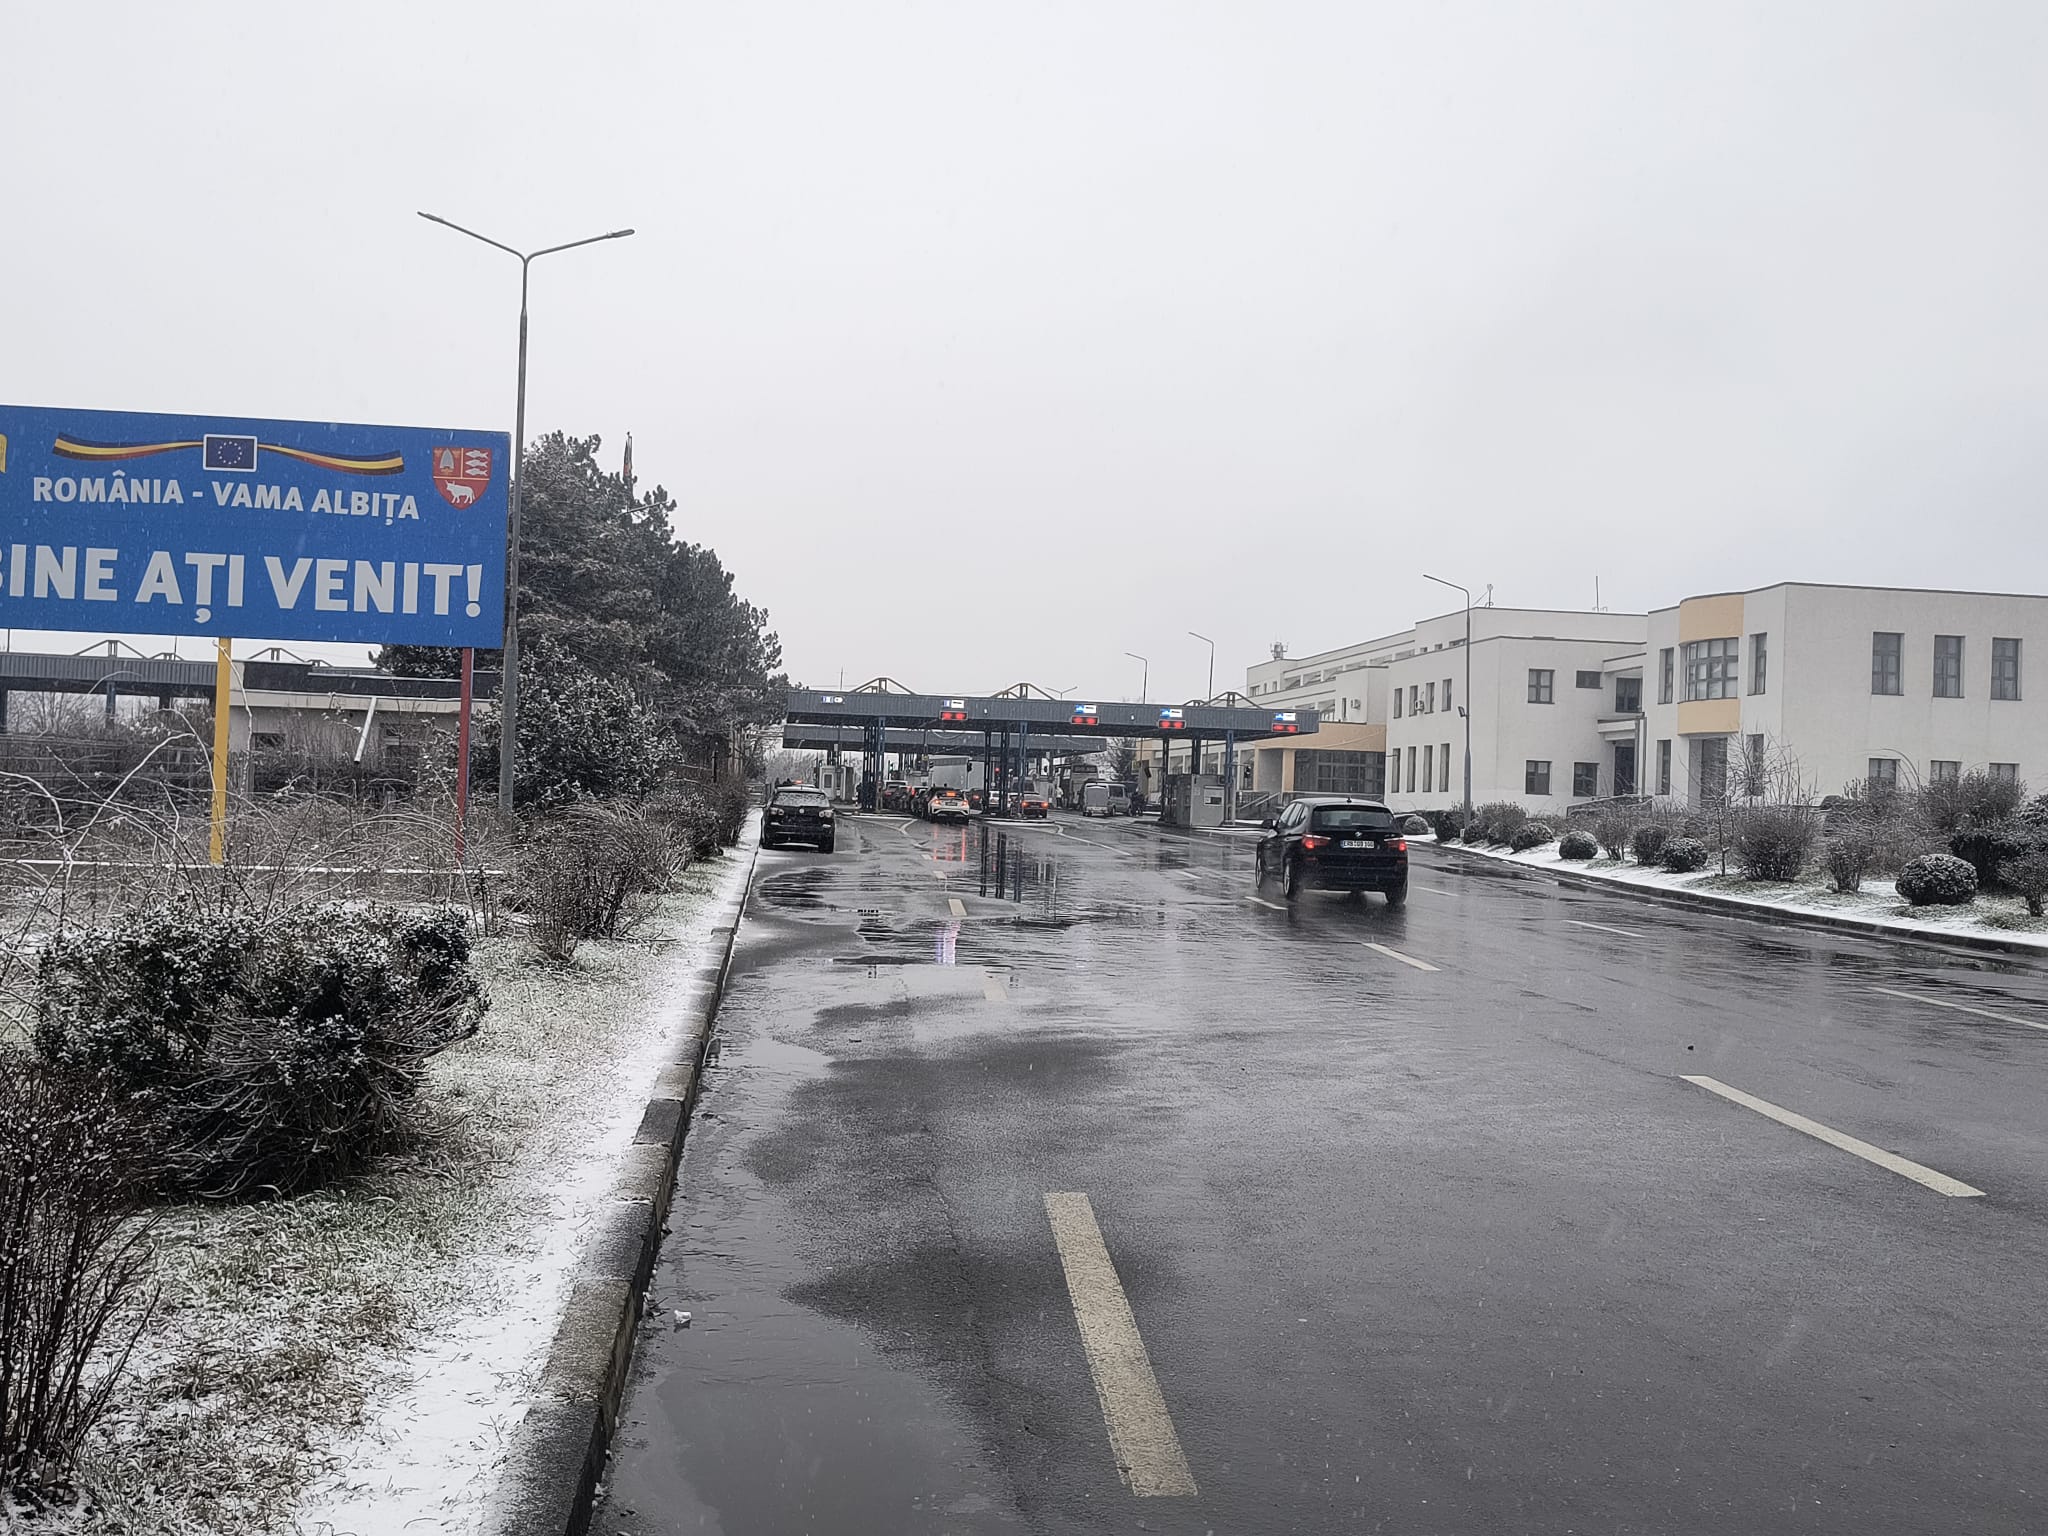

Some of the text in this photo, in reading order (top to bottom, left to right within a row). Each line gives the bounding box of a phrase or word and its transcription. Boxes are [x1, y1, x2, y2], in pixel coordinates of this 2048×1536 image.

[33, 469, 184, 504] ROMÂNIA
[211, 481, 304, 511] VAMA
[311, 488, 420, 526] ALBIȚA
[0, 543, 483, 624] INE AȚI VENIT!
